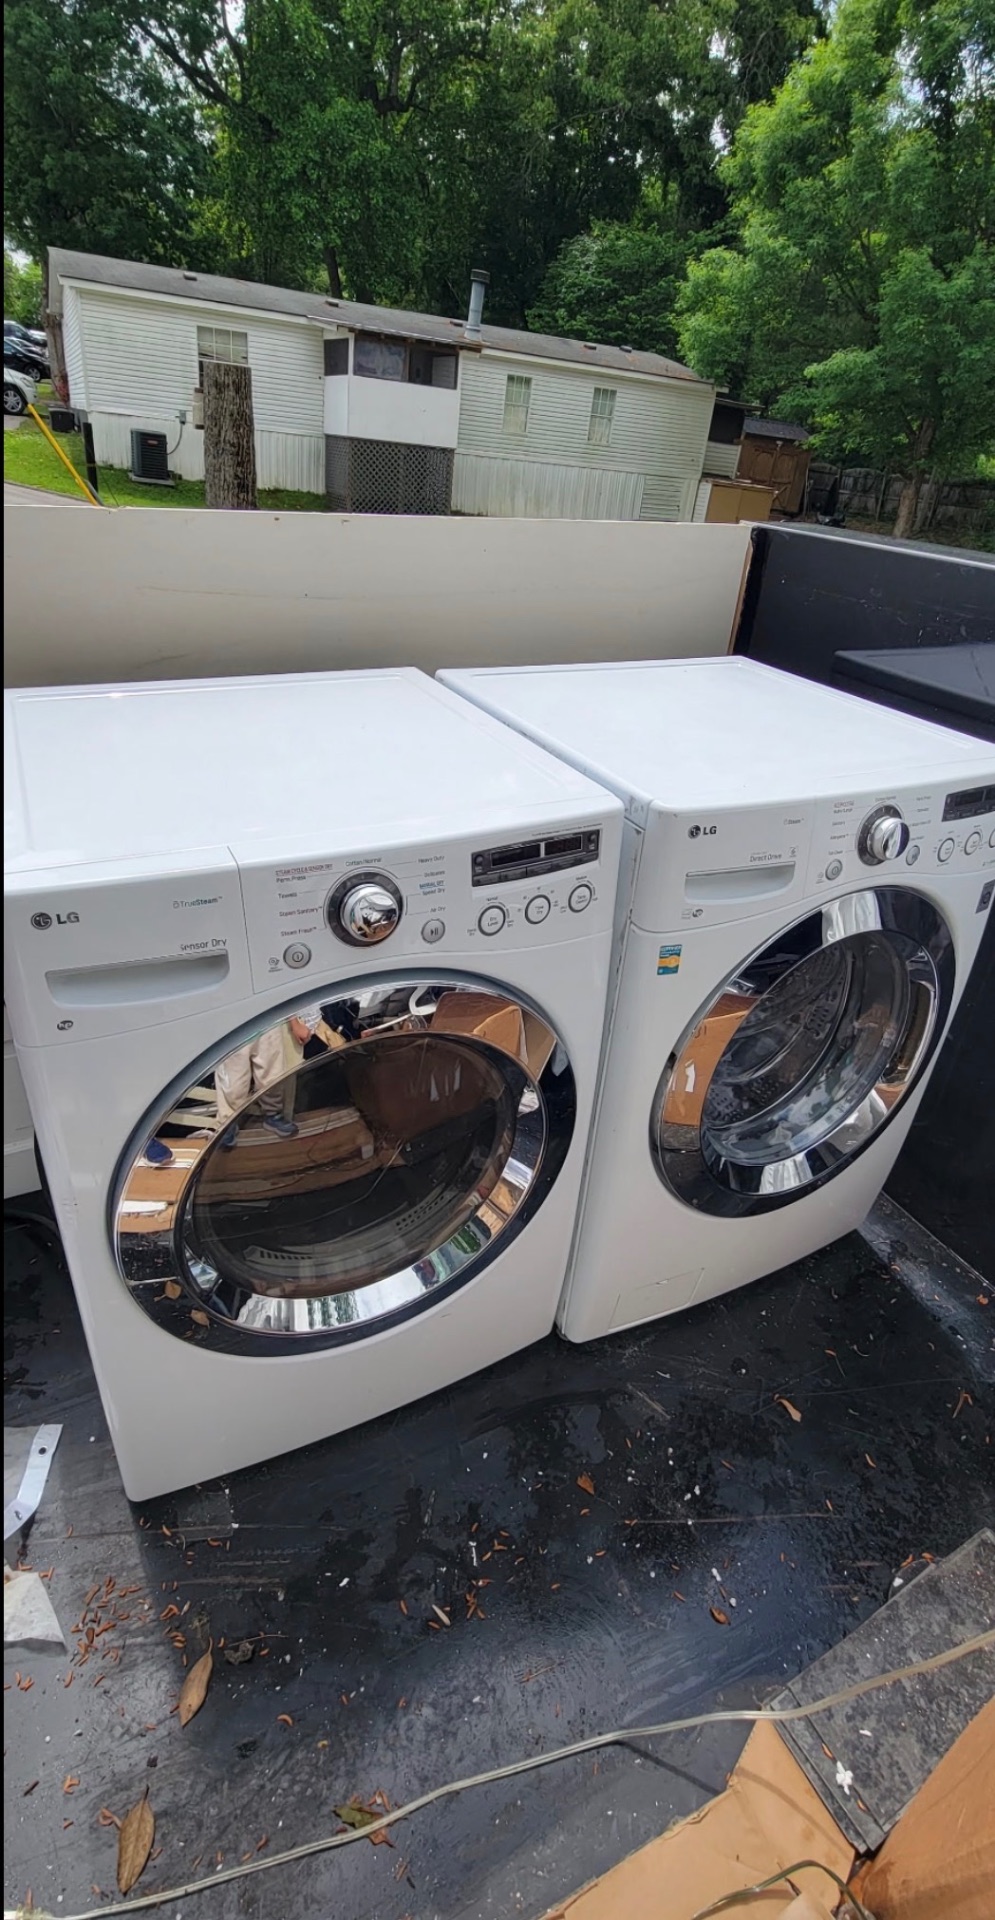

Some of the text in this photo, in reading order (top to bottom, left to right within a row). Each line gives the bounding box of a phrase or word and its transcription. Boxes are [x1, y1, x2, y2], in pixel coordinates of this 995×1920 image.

[703, 825, 717, 836] LG
[750, 854, 767, 863] Direct
[56, 911, 80, 925] LG
[180, 938, 227, 951] Sensor Dry
